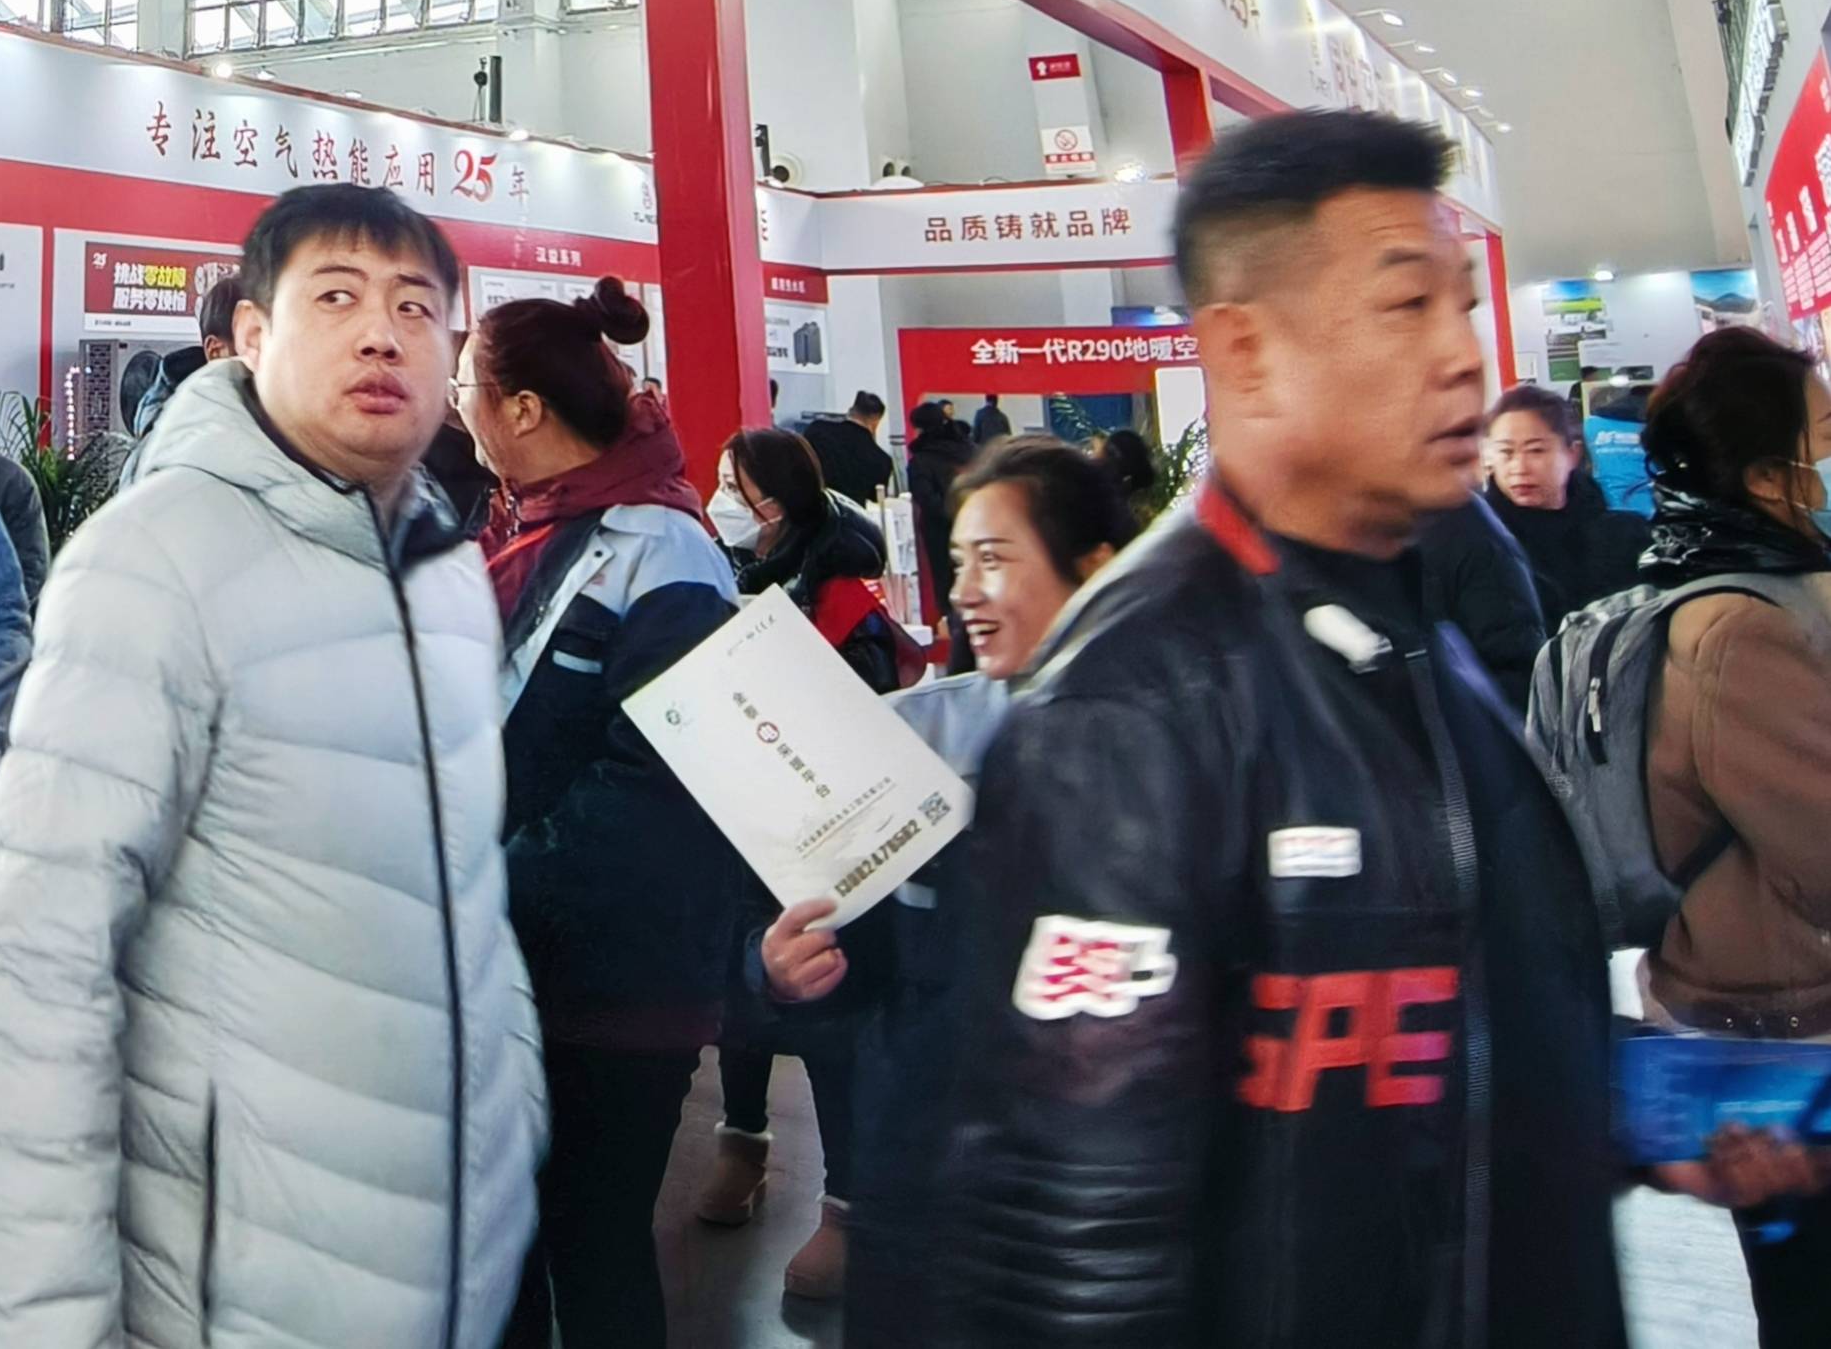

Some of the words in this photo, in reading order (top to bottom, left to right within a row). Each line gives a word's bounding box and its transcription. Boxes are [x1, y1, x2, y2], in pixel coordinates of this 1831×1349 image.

[146, 101, 531, 205] 专注空气热能应用25年
[924, 208, 1131, 243] 品质铸就品牌
[970, 335, 1200, 366] 全新一代R290地暖空
